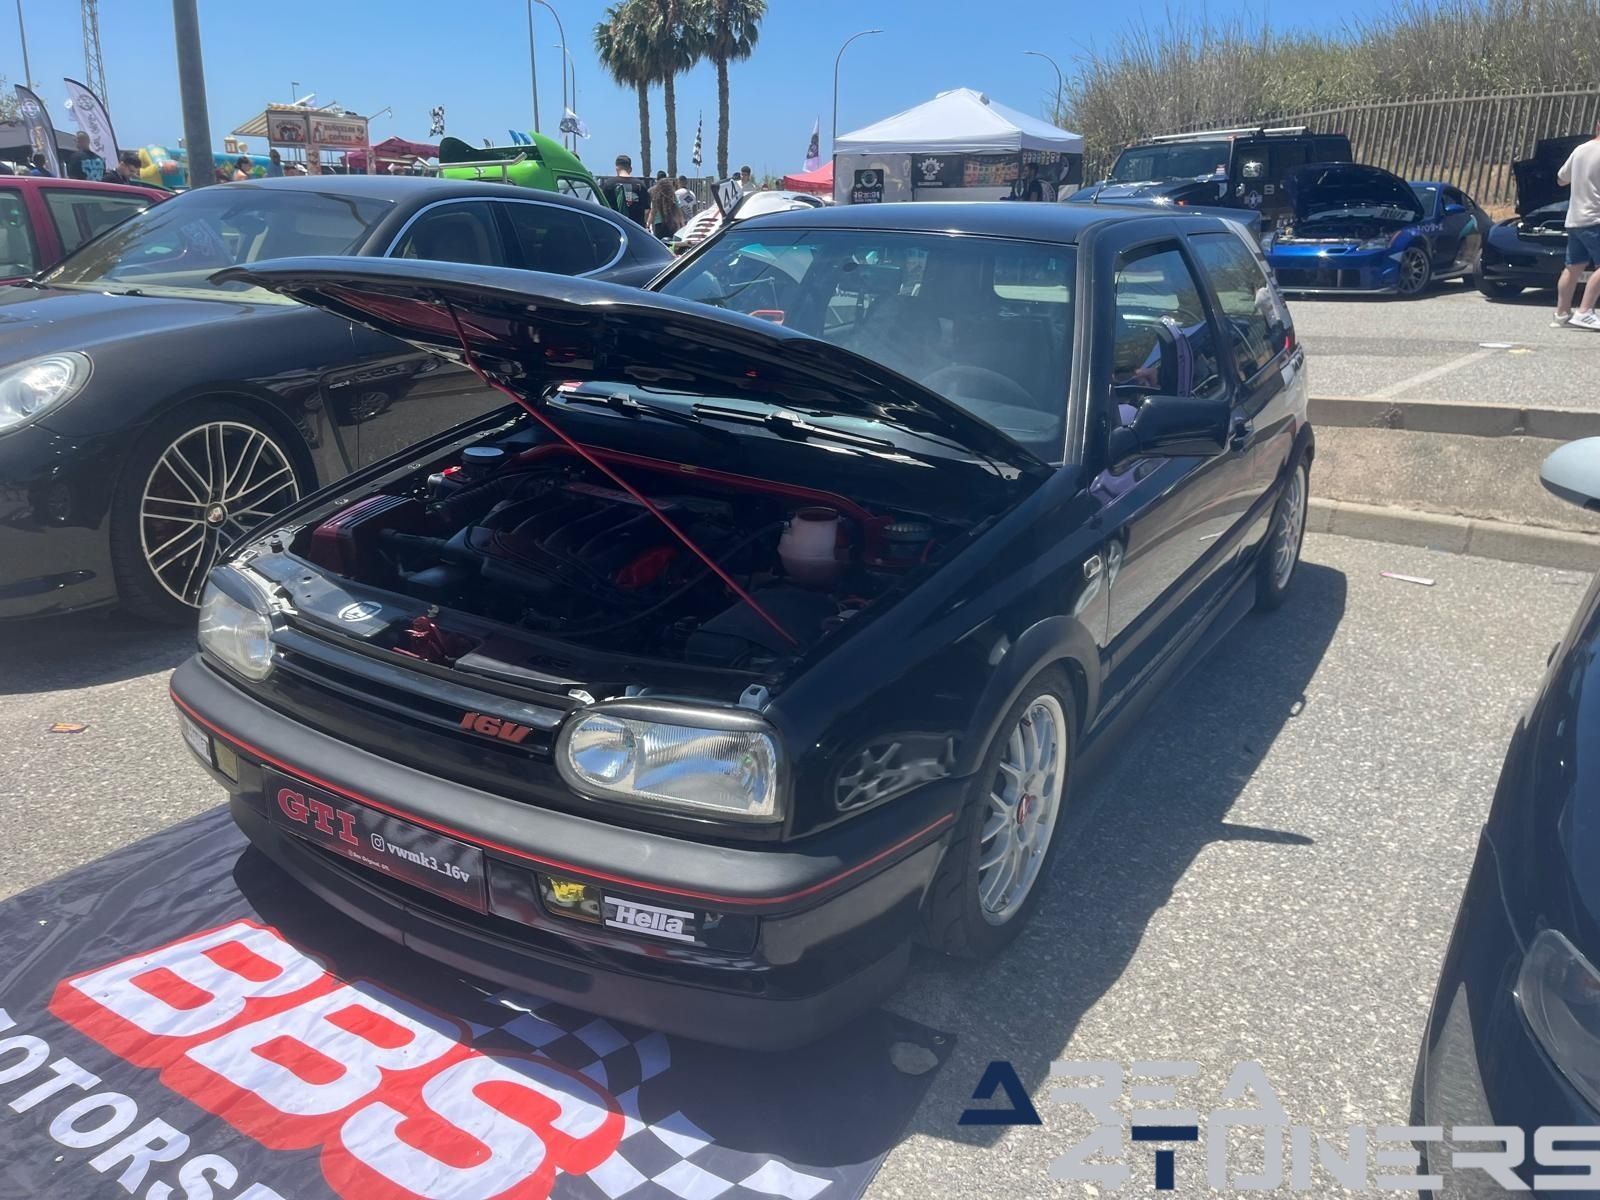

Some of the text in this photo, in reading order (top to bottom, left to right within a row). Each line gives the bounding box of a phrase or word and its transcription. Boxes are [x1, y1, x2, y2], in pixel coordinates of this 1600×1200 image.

[458, 711, 533, 744] 16V
[277, 788, 359, 846] GTI
[386, 842, 470, 882] vwmk3_16v
[615, 904, 684, 934] Hella
[55, 920, 622, 1200] BBS
[0, 1007, 287, 1200] OTORS
